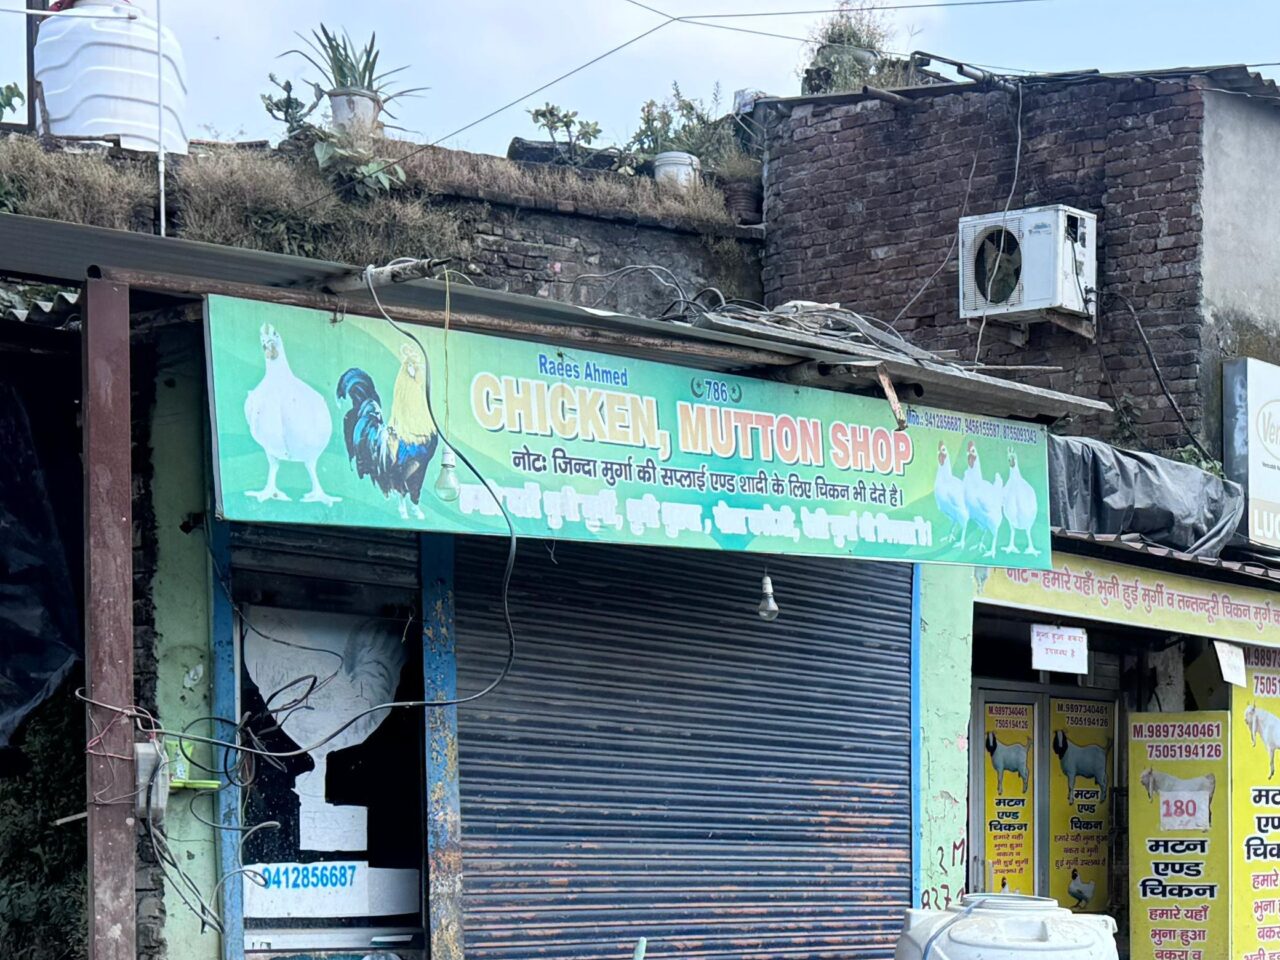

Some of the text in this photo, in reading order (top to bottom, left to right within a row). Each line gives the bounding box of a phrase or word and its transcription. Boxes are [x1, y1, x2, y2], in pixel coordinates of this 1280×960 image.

[538, 354, 628, 386] Raees Ahmed
[705, 380, 728, 401] 786
[471, 373, 913, 476] CHICKEN, MUTTON SHOP
[552, 447, 597, 478] जिन्दा
[601, 456, 633, 487] मुर्गा
[637, 458, 657, 484] की
[660, 465, 705, 491] सप्लाई
[709, 472, 736, 494] एण्ड
[739, 470, 768, 495] शादी
[771, 473, 785, 496] के
[789, 473, 812, 499] लिए
[815, 475, 850, 501] चिकन
[853, 479, 867, 503] भी
[869, 482, 887, 504] देते
[888, 485, 904, 507] है।
[1042, 566, 1071, 591] हमारे
[1073, 570, 1095, 596] यहाँ
[1097, 575, 1120, 607] भुनी
[1122, 579, 1139, 610] हुई
[1141, 583, 1165, 614] मुर्गी
[1166, 591, 1175, 609] व
[1221, 594, 1251, 621] चिकन
[1132, 722, 1221, 739] M.9897340461
[1147, 743, 1222, 759] 7505194126
[994, 798, 1026, 807] मटन
[1074, 789, 1100, 800] मटन
[996, 811, 1020, 820] एण्ड
[1076, 803, 1097, 814] एण्ड
[1162, 799, 1197, 818] 180
[988, 819, 1028, 832] चिकन
[1069, 817, 1103, 831] चिकन
[1146, 839, 1208, 854] मटन
[262, 864, 357, 889] 9412856687
[1150, 861, 1203, 877] एण्ड
[1139, 878, 1217, 899] चिकन
[1251, 870, 1279, 890] हमारे
[1148, 904, 1209, 921] हमारे यहाँ
[1253, 899, 1275, 921] भुना
[1151, 928, 1206, 946] भुना हुआ
[1192, 950, 1202, 960] व
